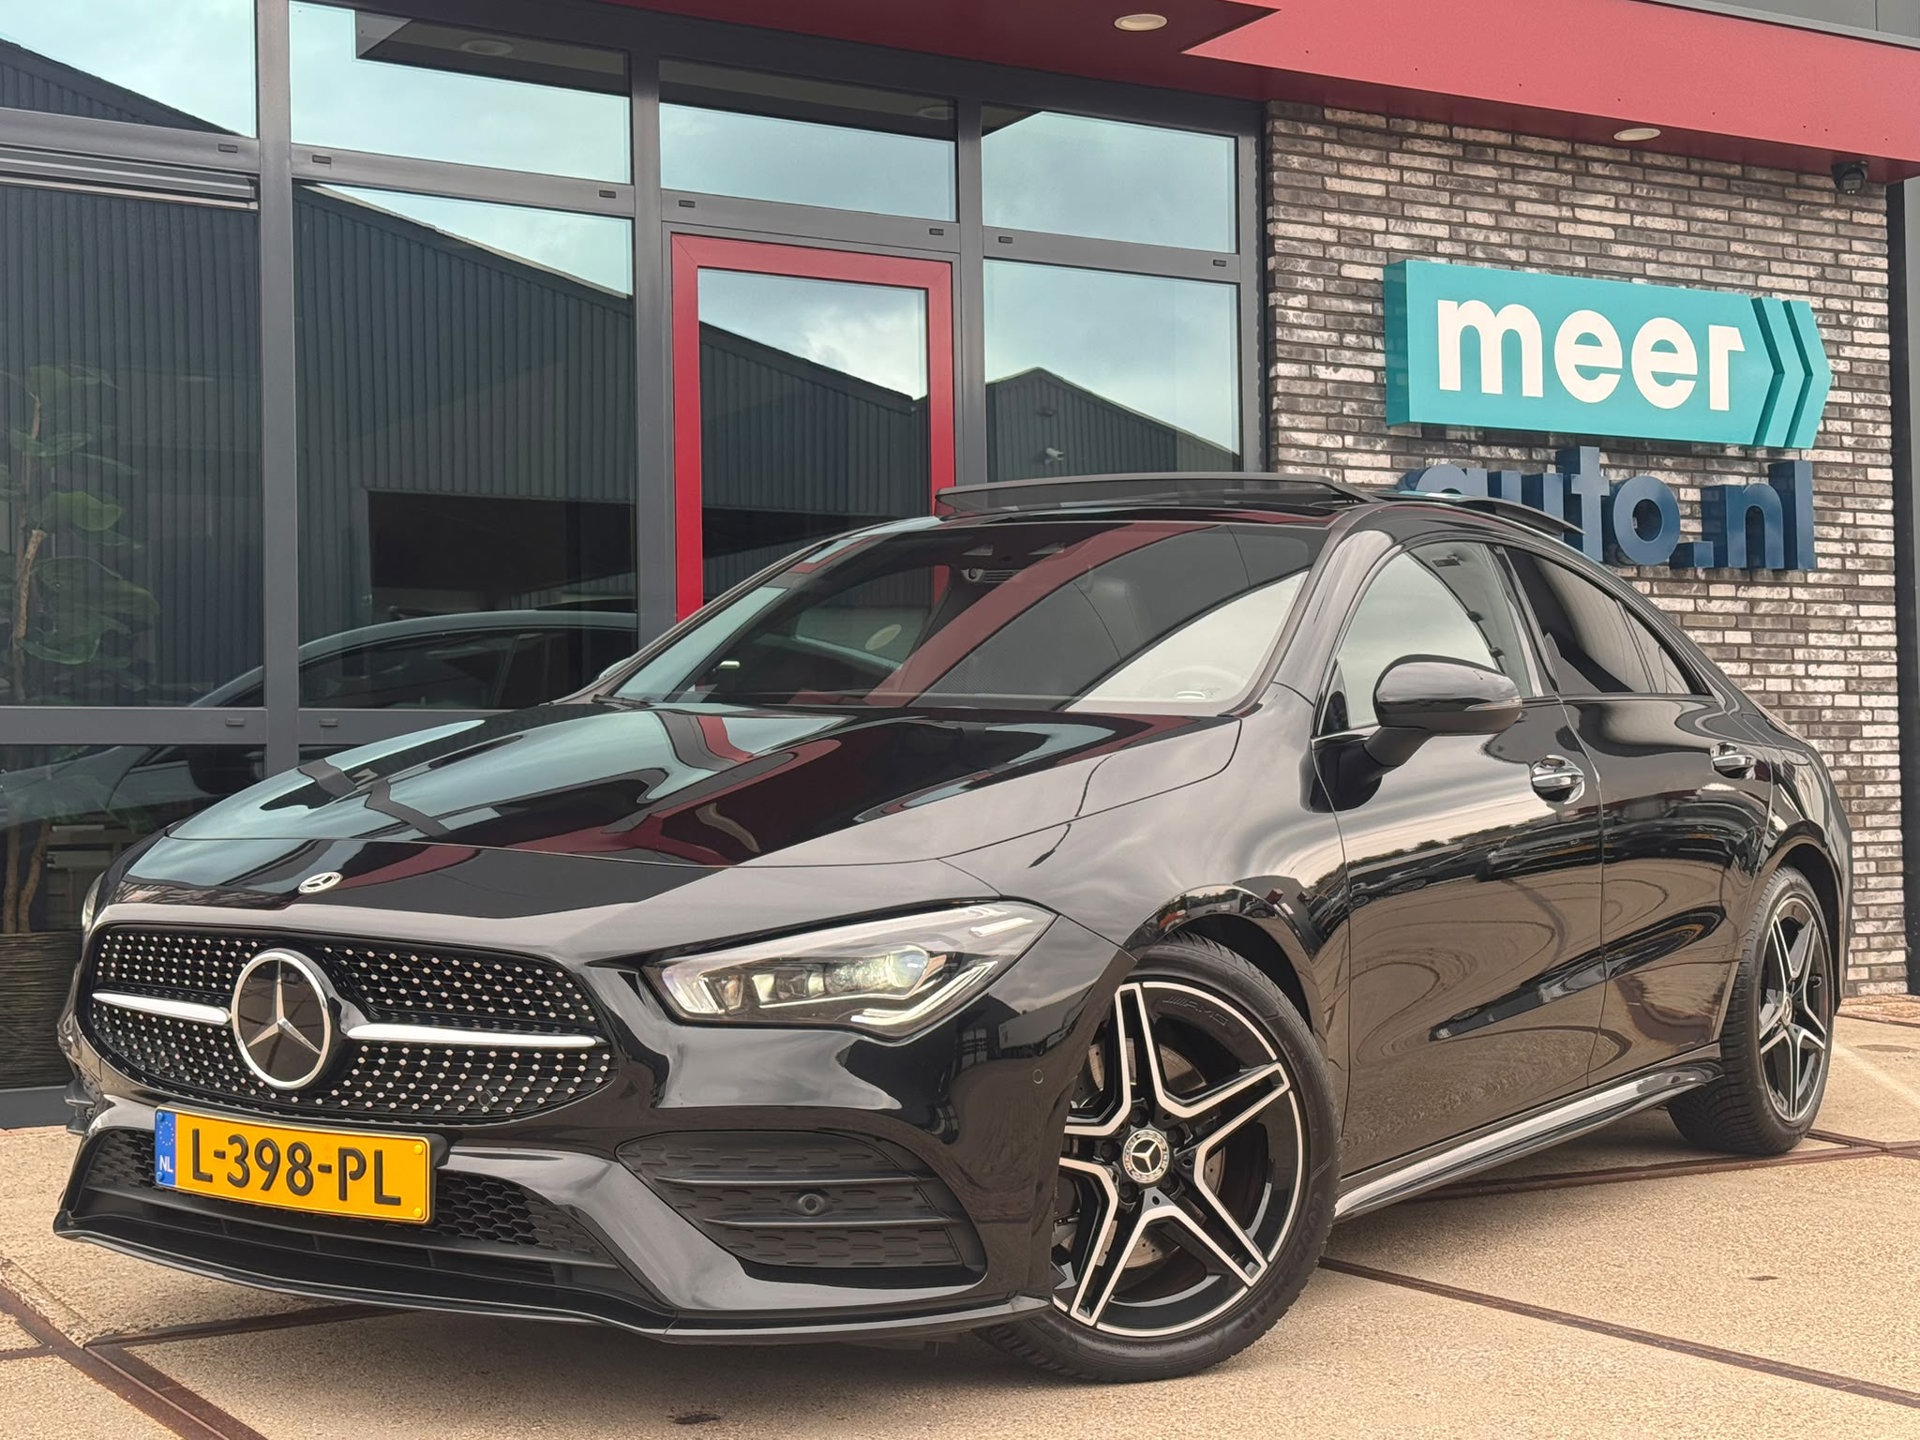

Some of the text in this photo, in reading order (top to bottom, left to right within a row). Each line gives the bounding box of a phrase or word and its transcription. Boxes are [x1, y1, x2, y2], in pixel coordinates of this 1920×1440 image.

[1437, 300, 1745, 411] meer
[159, 1154, 173, 1174] NL
[192, 1128, 402, 1206] L-398-PL
